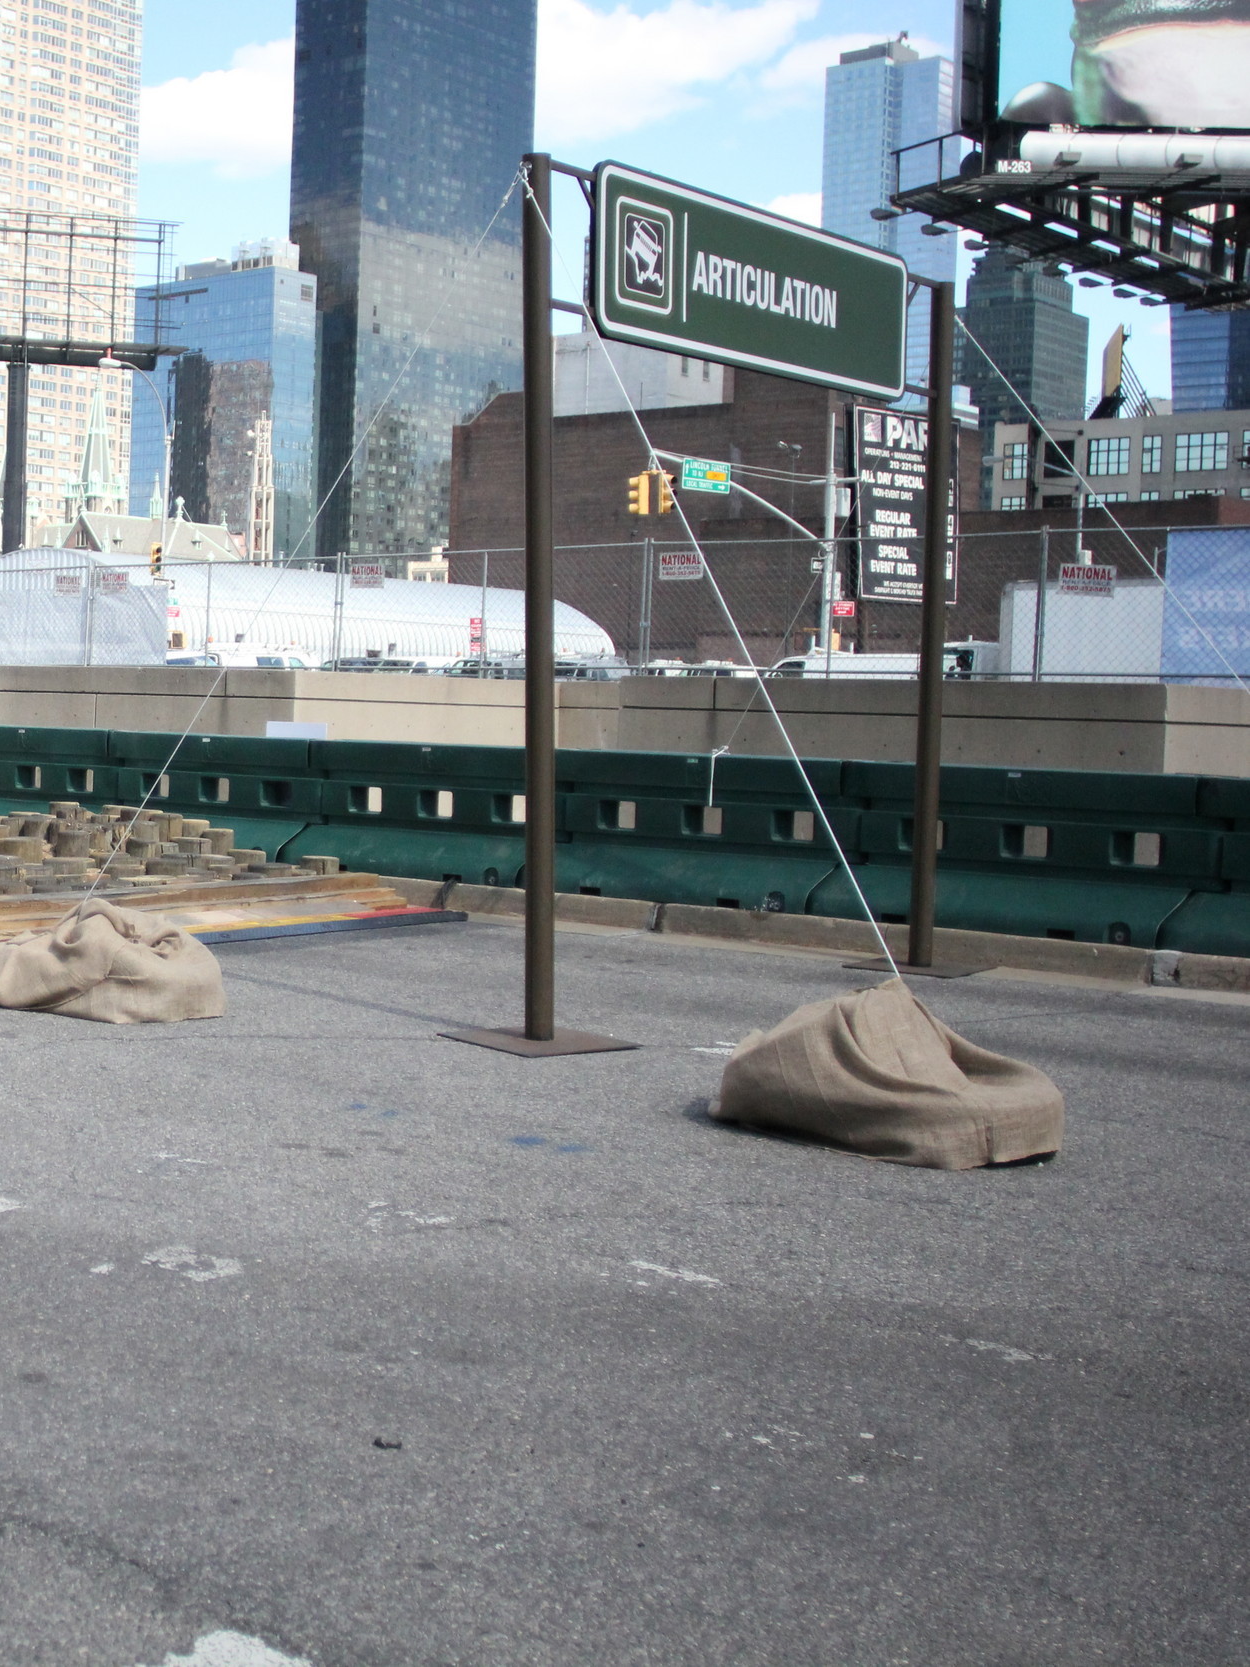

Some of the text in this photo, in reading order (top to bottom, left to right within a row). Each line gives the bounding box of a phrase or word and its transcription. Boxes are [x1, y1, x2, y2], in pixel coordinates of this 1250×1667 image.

[997, 160, 1032, 173] M-263
[692, 251, 837, 328] ARTICULATION
[860, 469, 925, 489] ALL DAY SPECIAL
[875, 509, 911, 525] REGULAR
[869, 524, 918, 538] EVENT RATE
[878, 544, 909, 560] SPECIAL
[661, 554, 702, 566] NATIONAL
[870, 559, 917, 576] EVENT RATE
[102, 572, 128, 583] NATIONAL
[351, 565, 384, 576] NATIONAL
[1061, 566, 1113, 581] NATIONAL
